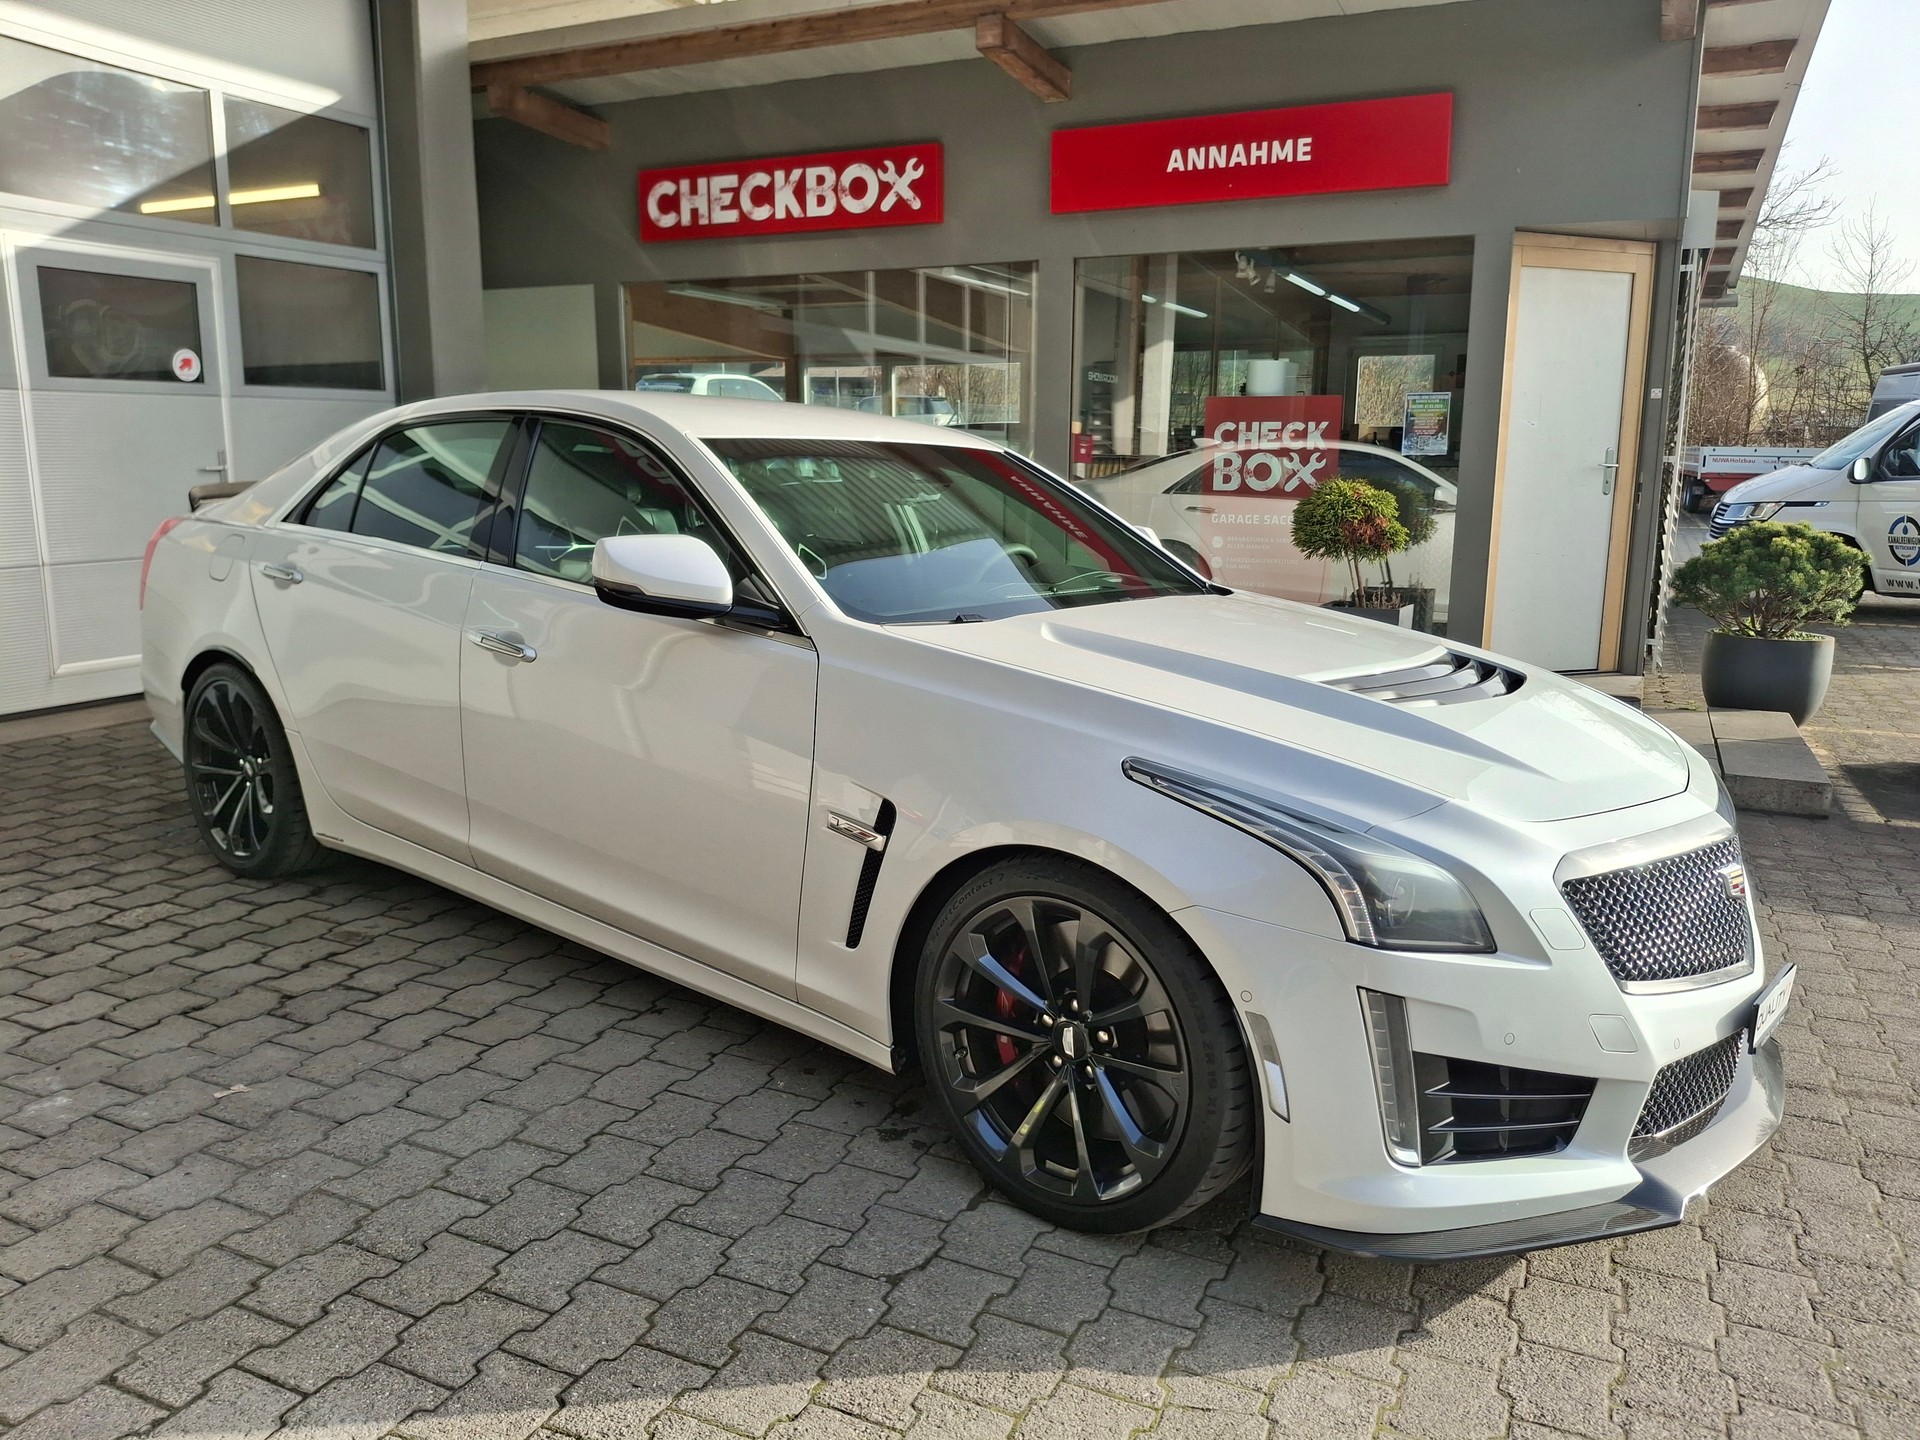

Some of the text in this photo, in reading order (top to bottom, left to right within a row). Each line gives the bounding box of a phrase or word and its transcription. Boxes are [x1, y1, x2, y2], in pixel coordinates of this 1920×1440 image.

[1166, 136, 1313, 173] ANNAHME
[646, 157, 925, 229] CHECKBOX
[1087, 371, 1119, 384] SHOWROOM
[1212, 420, 1329, 451] CHECK
[1212, 452, 1327, 492] BOX
[1211, 513, 1294, 526] GARAGE SACC
[1885, 578, 1920, 591] www.
[997, 872, 1005, 883] 7
